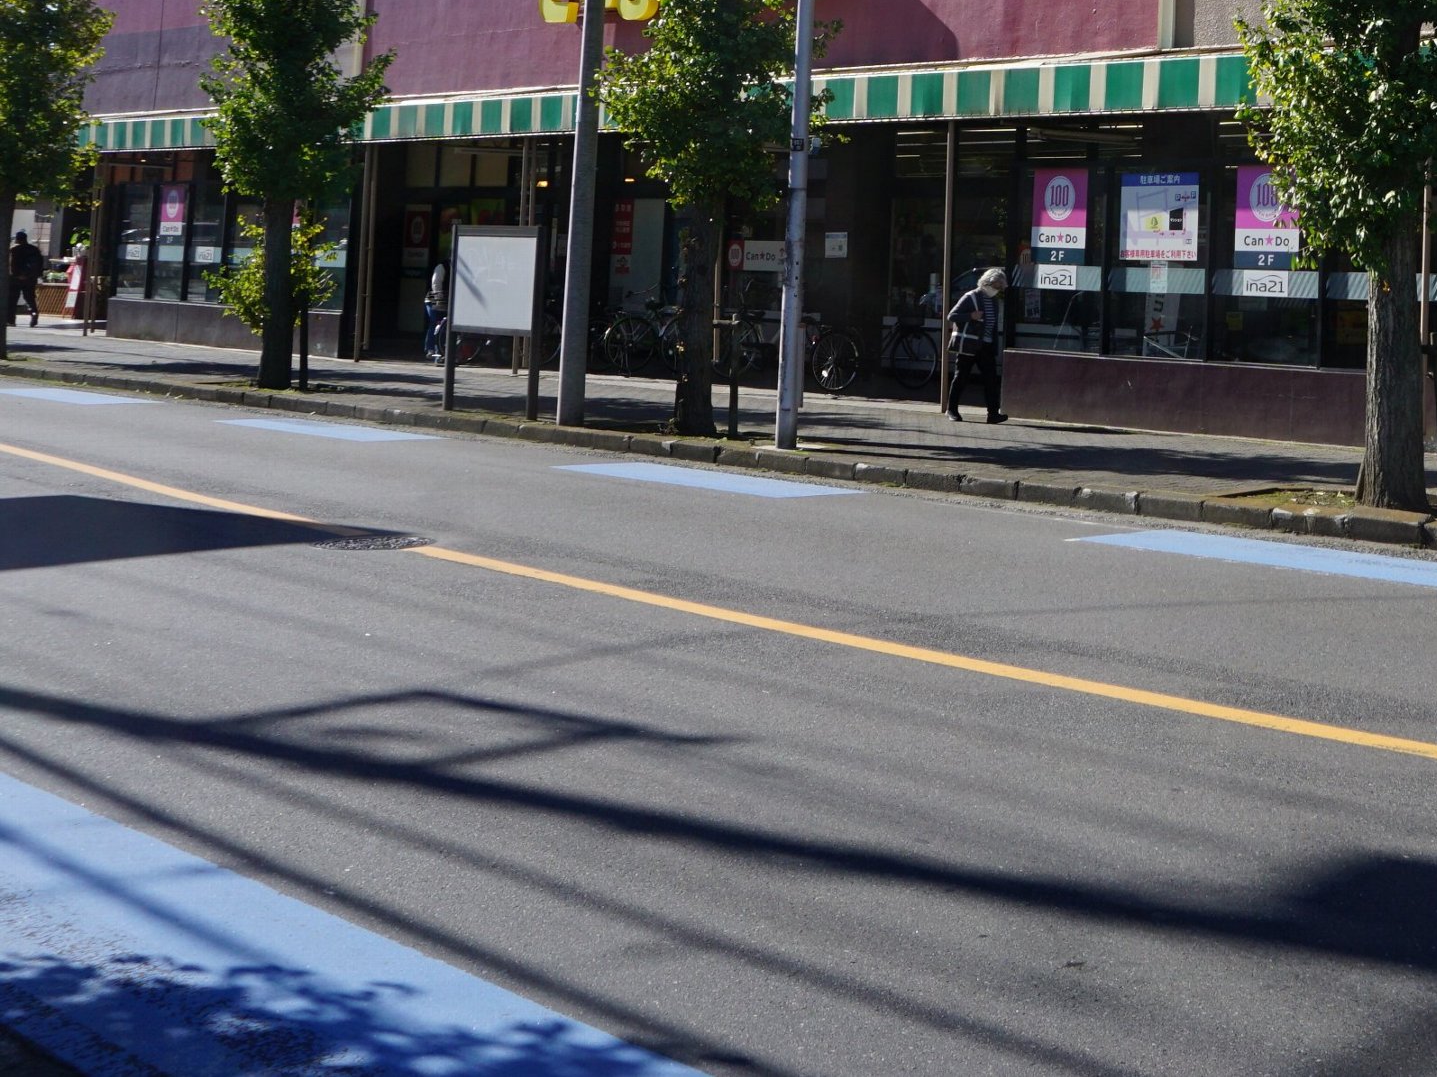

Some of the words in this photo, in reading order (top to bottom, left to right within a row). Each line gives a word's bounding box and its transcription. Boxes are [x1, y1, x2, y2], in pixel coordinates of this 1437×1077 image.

[1140, 174, 1181, 184] 駐車場ご案内
[1049, 184, 1070, 207] 100
[1050, 250, 1065, 261] 2F
[1257, 254, 1275, 266] 2F
[1040, 274, 1074, 286] ina21
[1246, 280, 1285, 293] ina21
